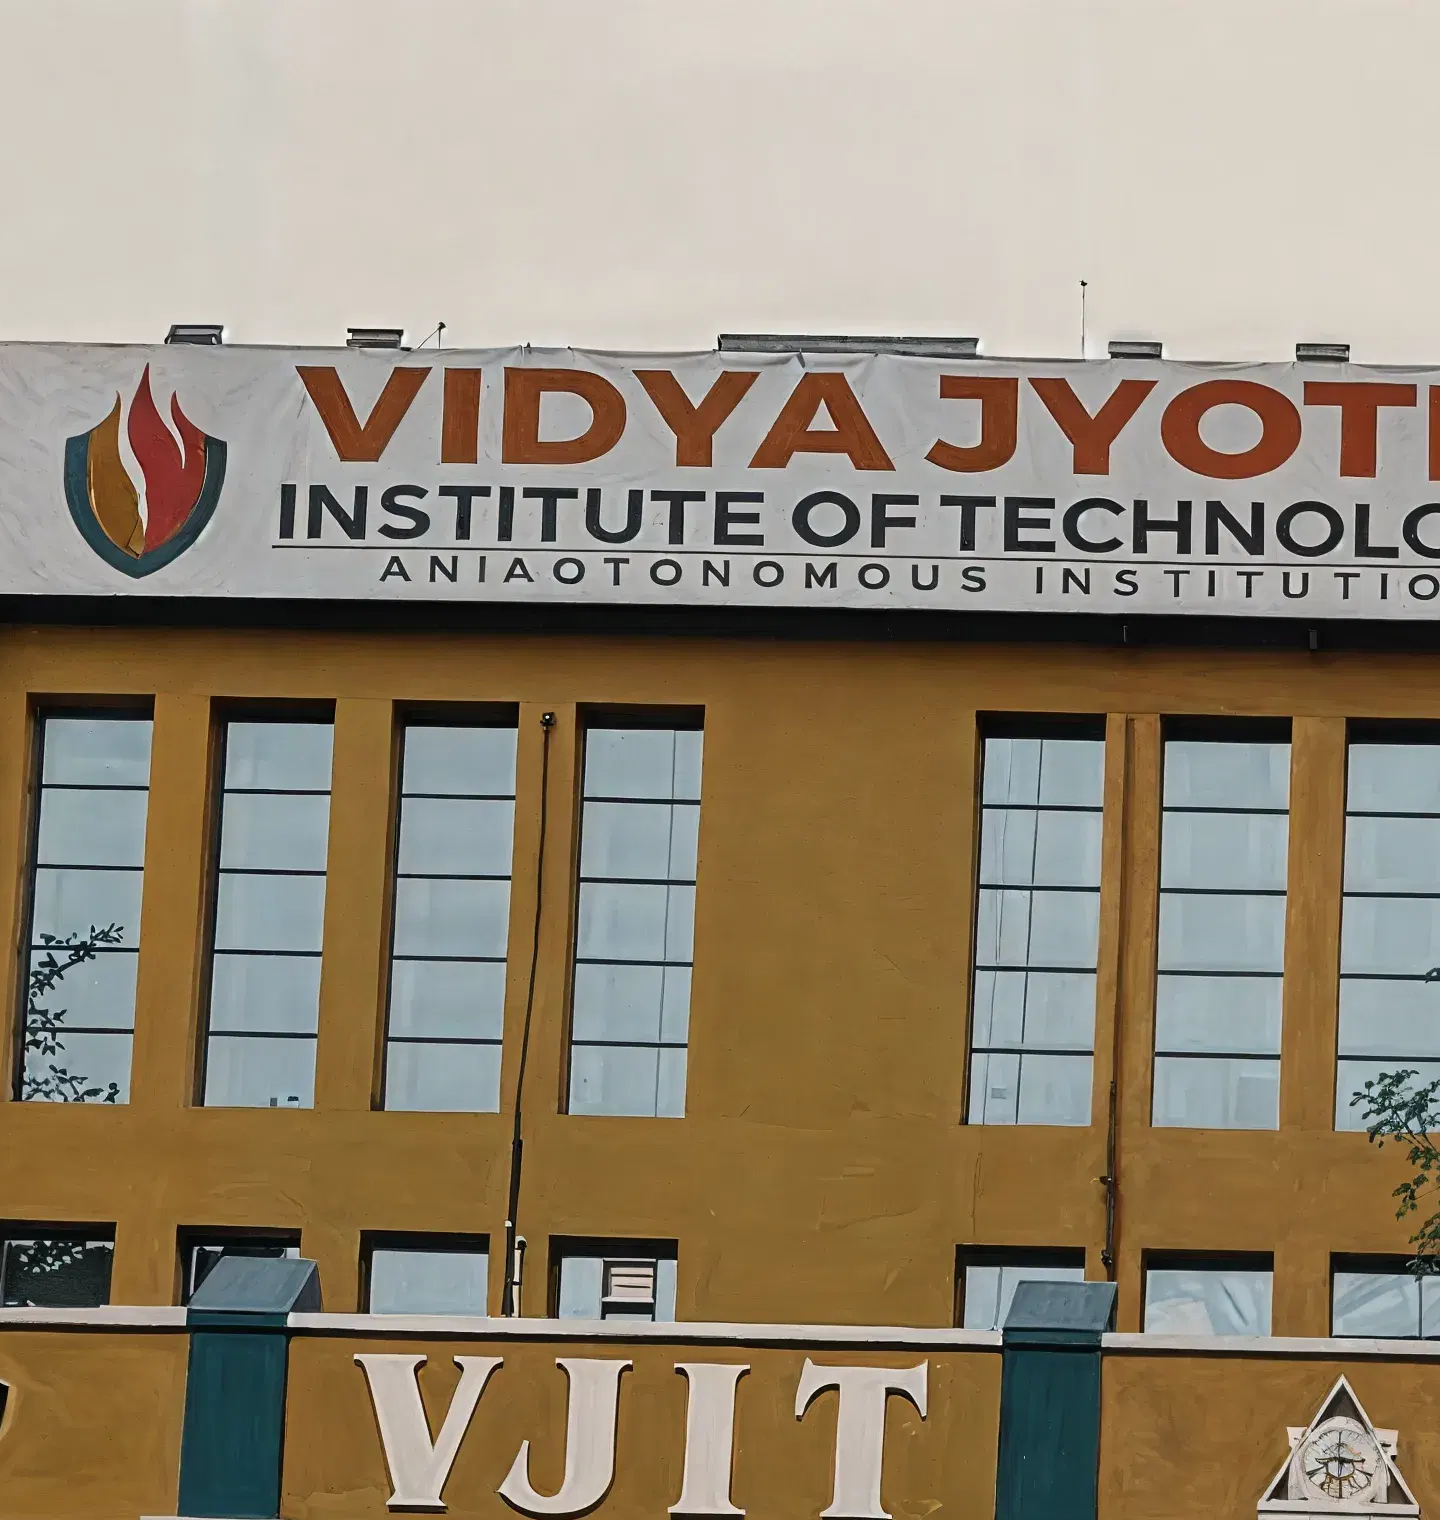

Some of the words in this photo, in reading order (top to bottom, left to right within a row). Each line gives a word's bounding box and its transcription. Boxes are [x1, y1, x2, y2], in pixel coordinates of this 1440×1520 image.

[295, 366, 896, 472] VIDYA
[279, 484, 765, 546] INSTITUTE
[792, 490, 919, 549] OF
